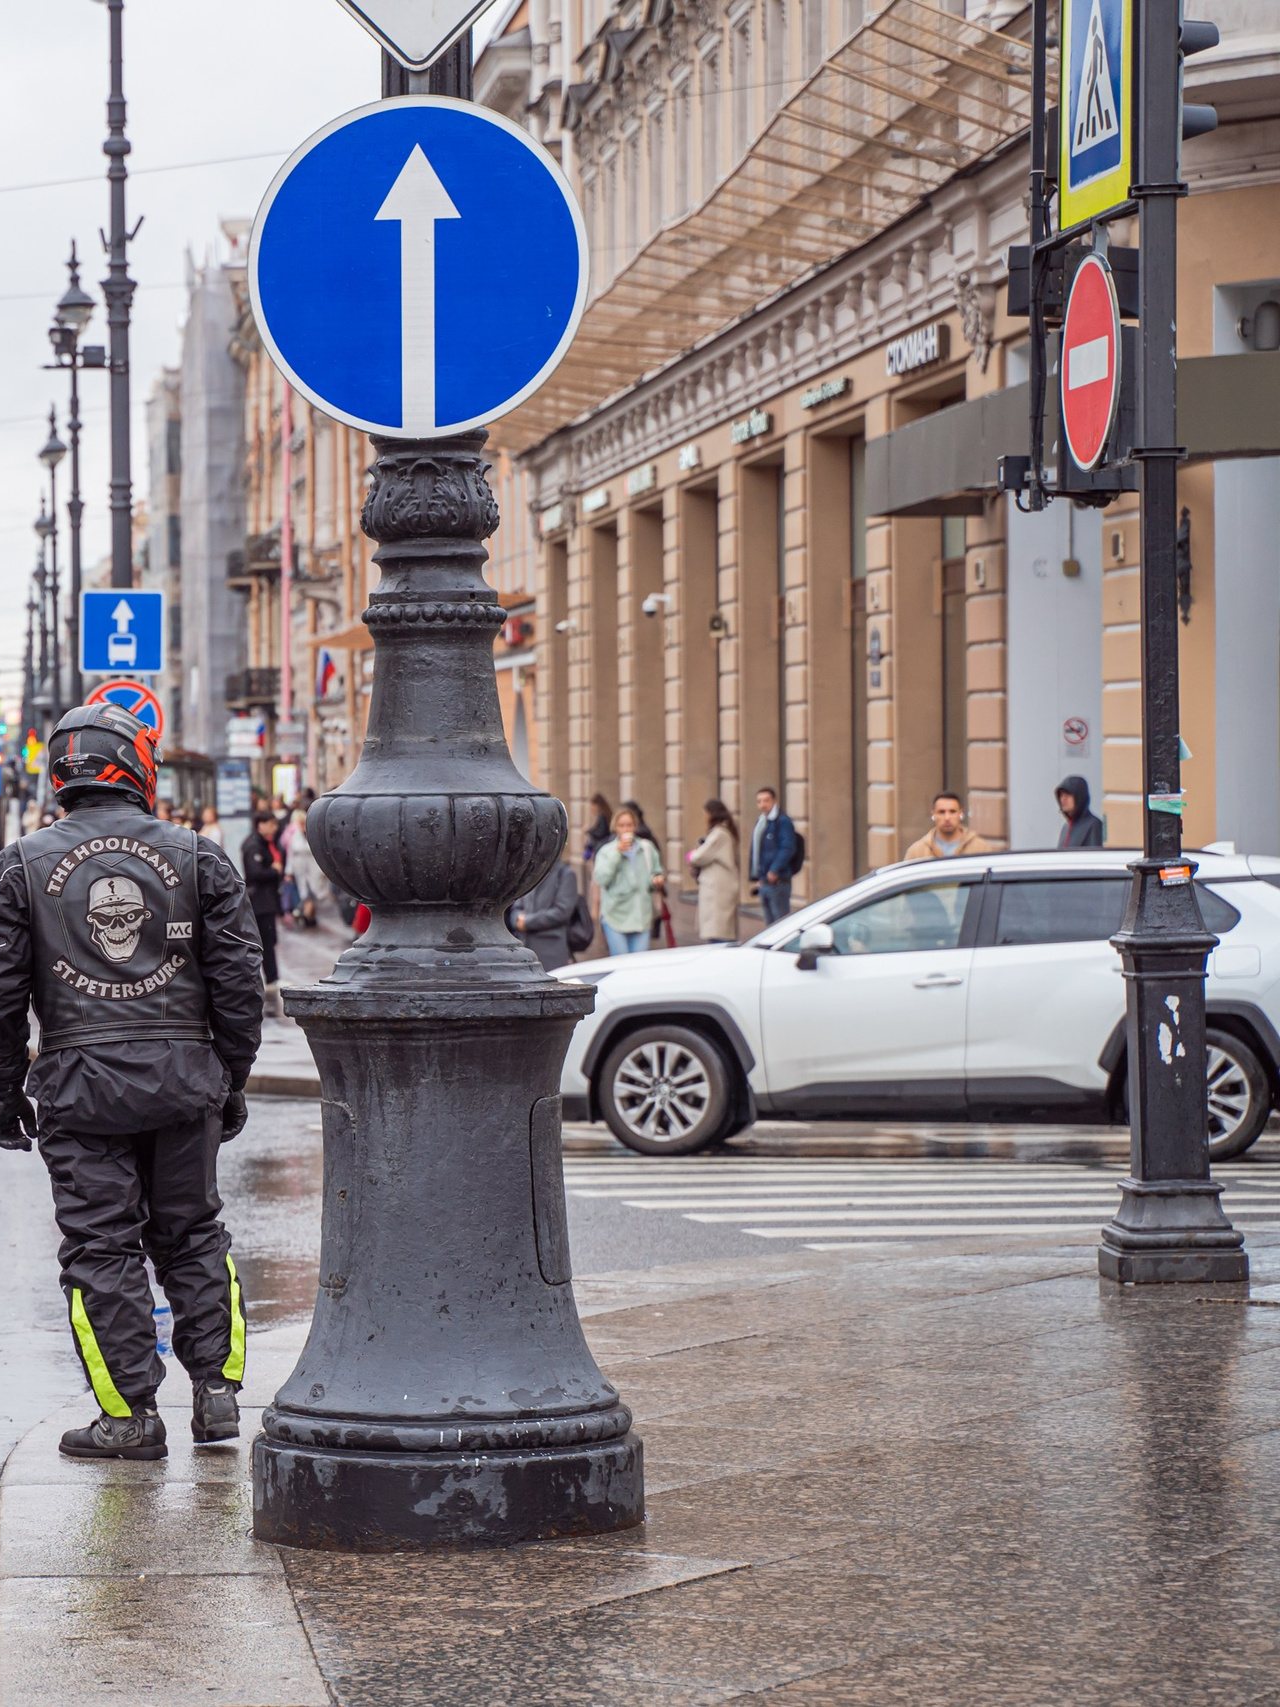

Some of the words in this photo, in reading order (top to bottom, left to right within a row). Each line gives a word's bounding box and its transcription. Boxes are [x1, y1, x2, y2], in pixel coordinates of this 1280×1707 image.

[885, 323, 939, 377] СТОКМАНН
[47, 859, 75, 893] THE
[73, 837, 180, 887] HOOLIGANS
[168, 924, 192, 936] MC
